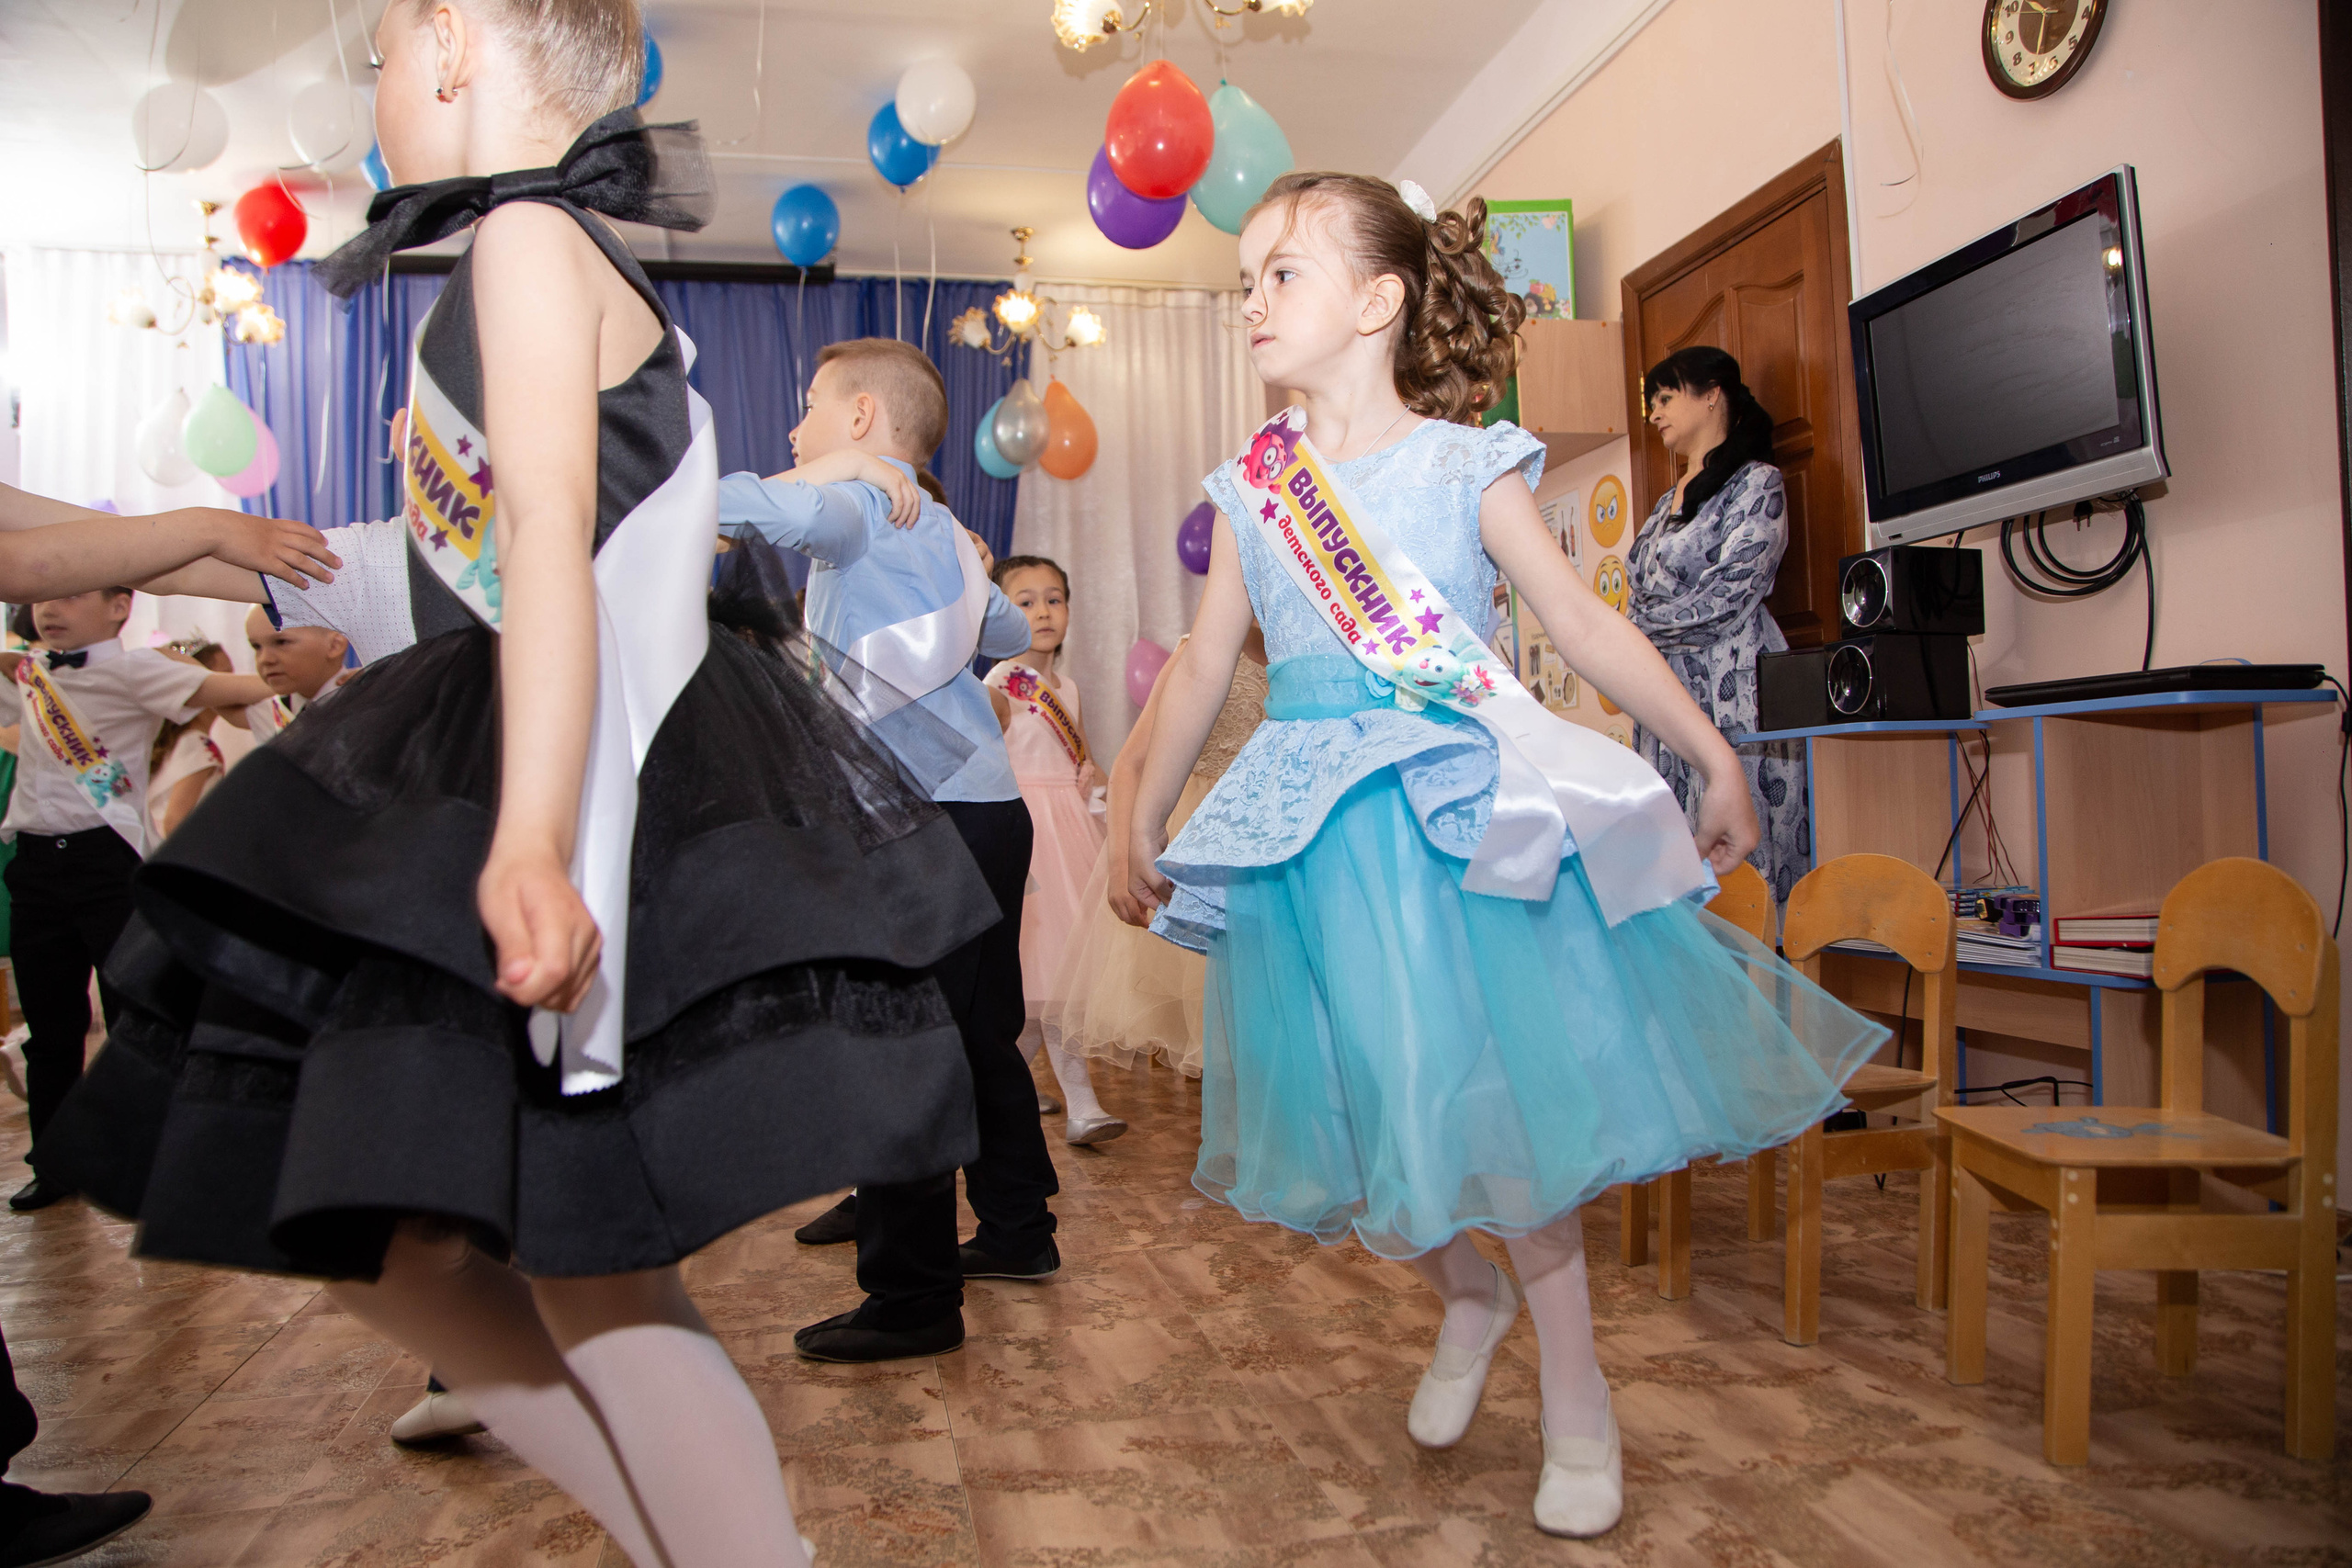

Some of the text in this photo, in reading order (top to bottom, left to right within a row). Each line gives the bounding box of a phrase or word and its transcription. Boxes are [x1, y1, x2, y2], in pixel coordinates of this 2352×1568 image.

[2004, 0, 2018, 18] 10
[2081, 6, 2091, 20] 4
[2005, 30, 2014, 45] 9
[2067, 35, 2078, 51] 5
[2012, 51, 2022, 67] 8
[2048, 55, 2058, 70] 6
[2028, 61, 2036, 76] 7
[1977, 470, 2001, 484] PHILIPS
[1287, 467, 1418, 657] ВЫПУСКНИК
[1277, 514, 1363, 645] детского сада
[1039, 690, 1086, 761] ВЫПУСК
